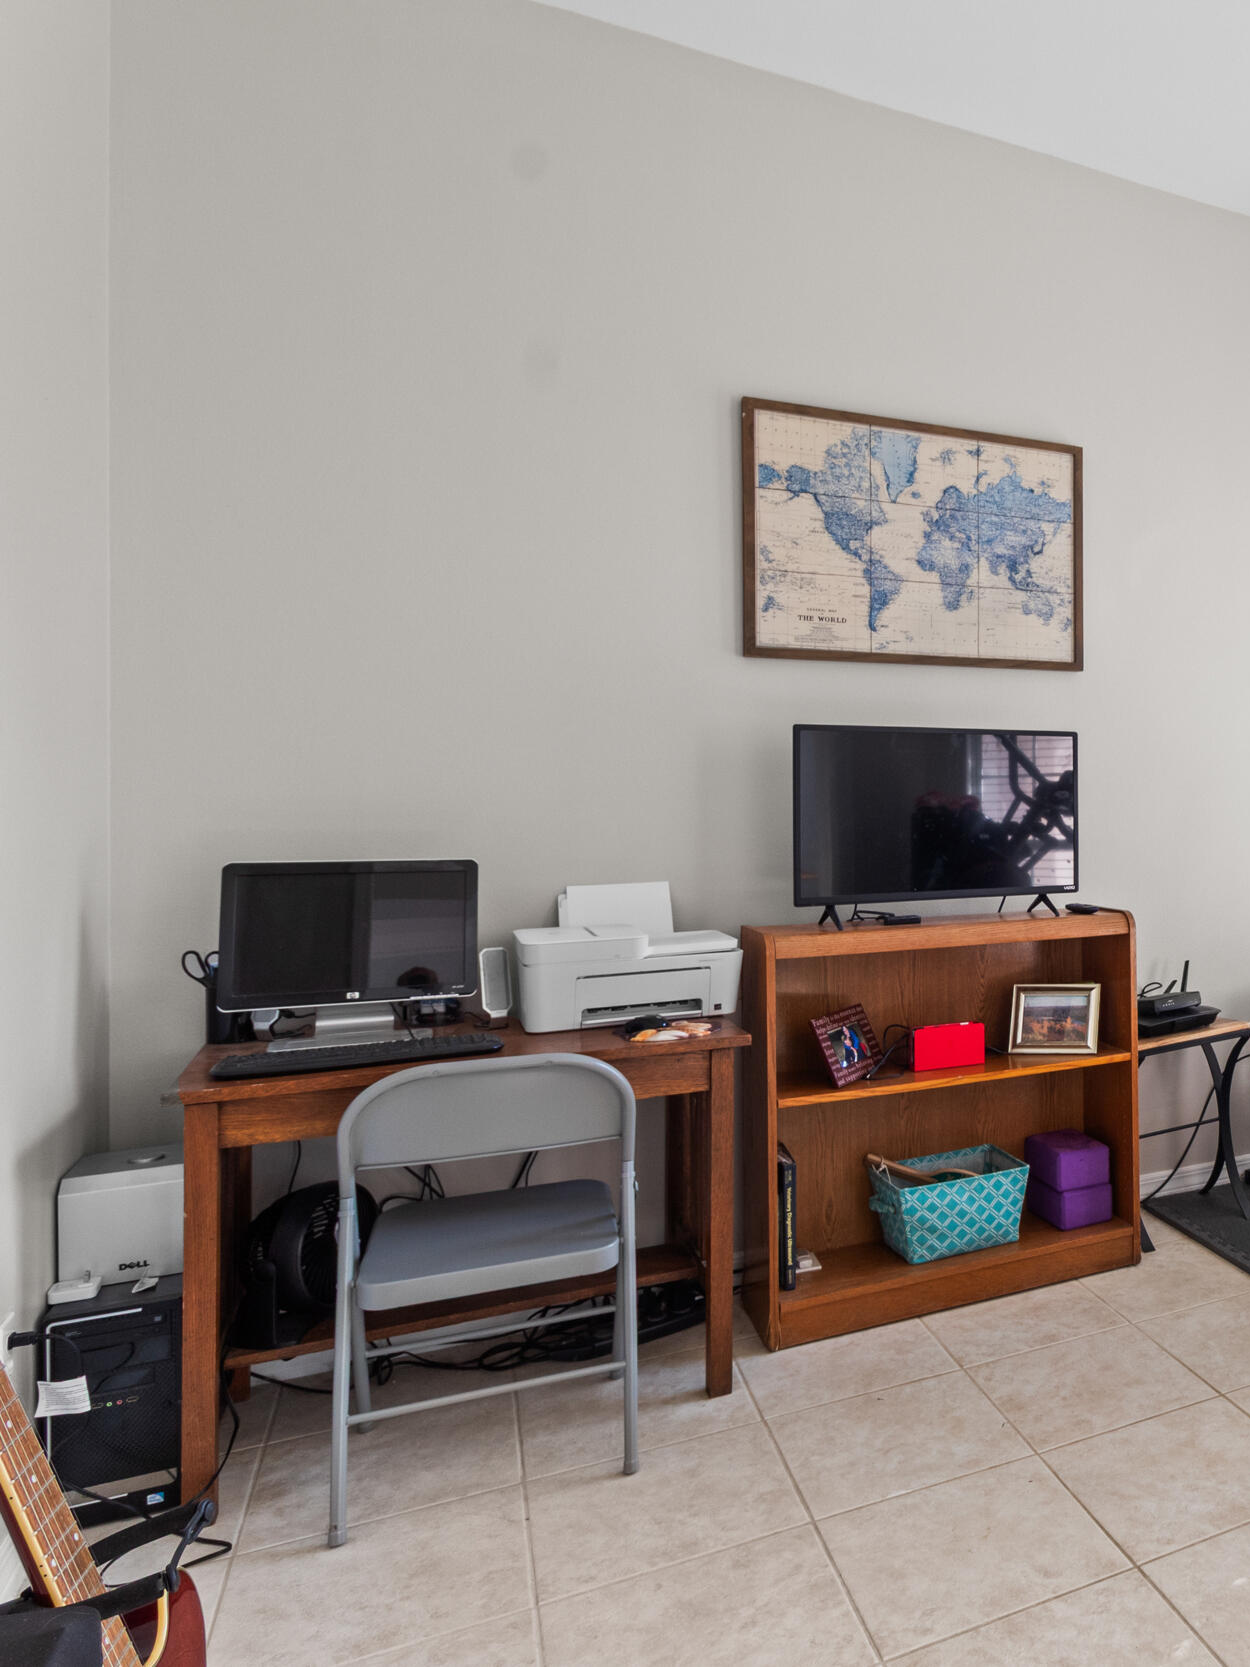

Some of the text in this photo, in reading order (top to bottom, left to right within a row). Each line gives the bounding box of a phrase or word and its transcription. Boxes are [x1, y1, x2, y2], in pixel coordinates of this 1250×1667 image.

[797, 614, 847, 624] THE WORLD
[119, 1260, 150, 1271] DELL
